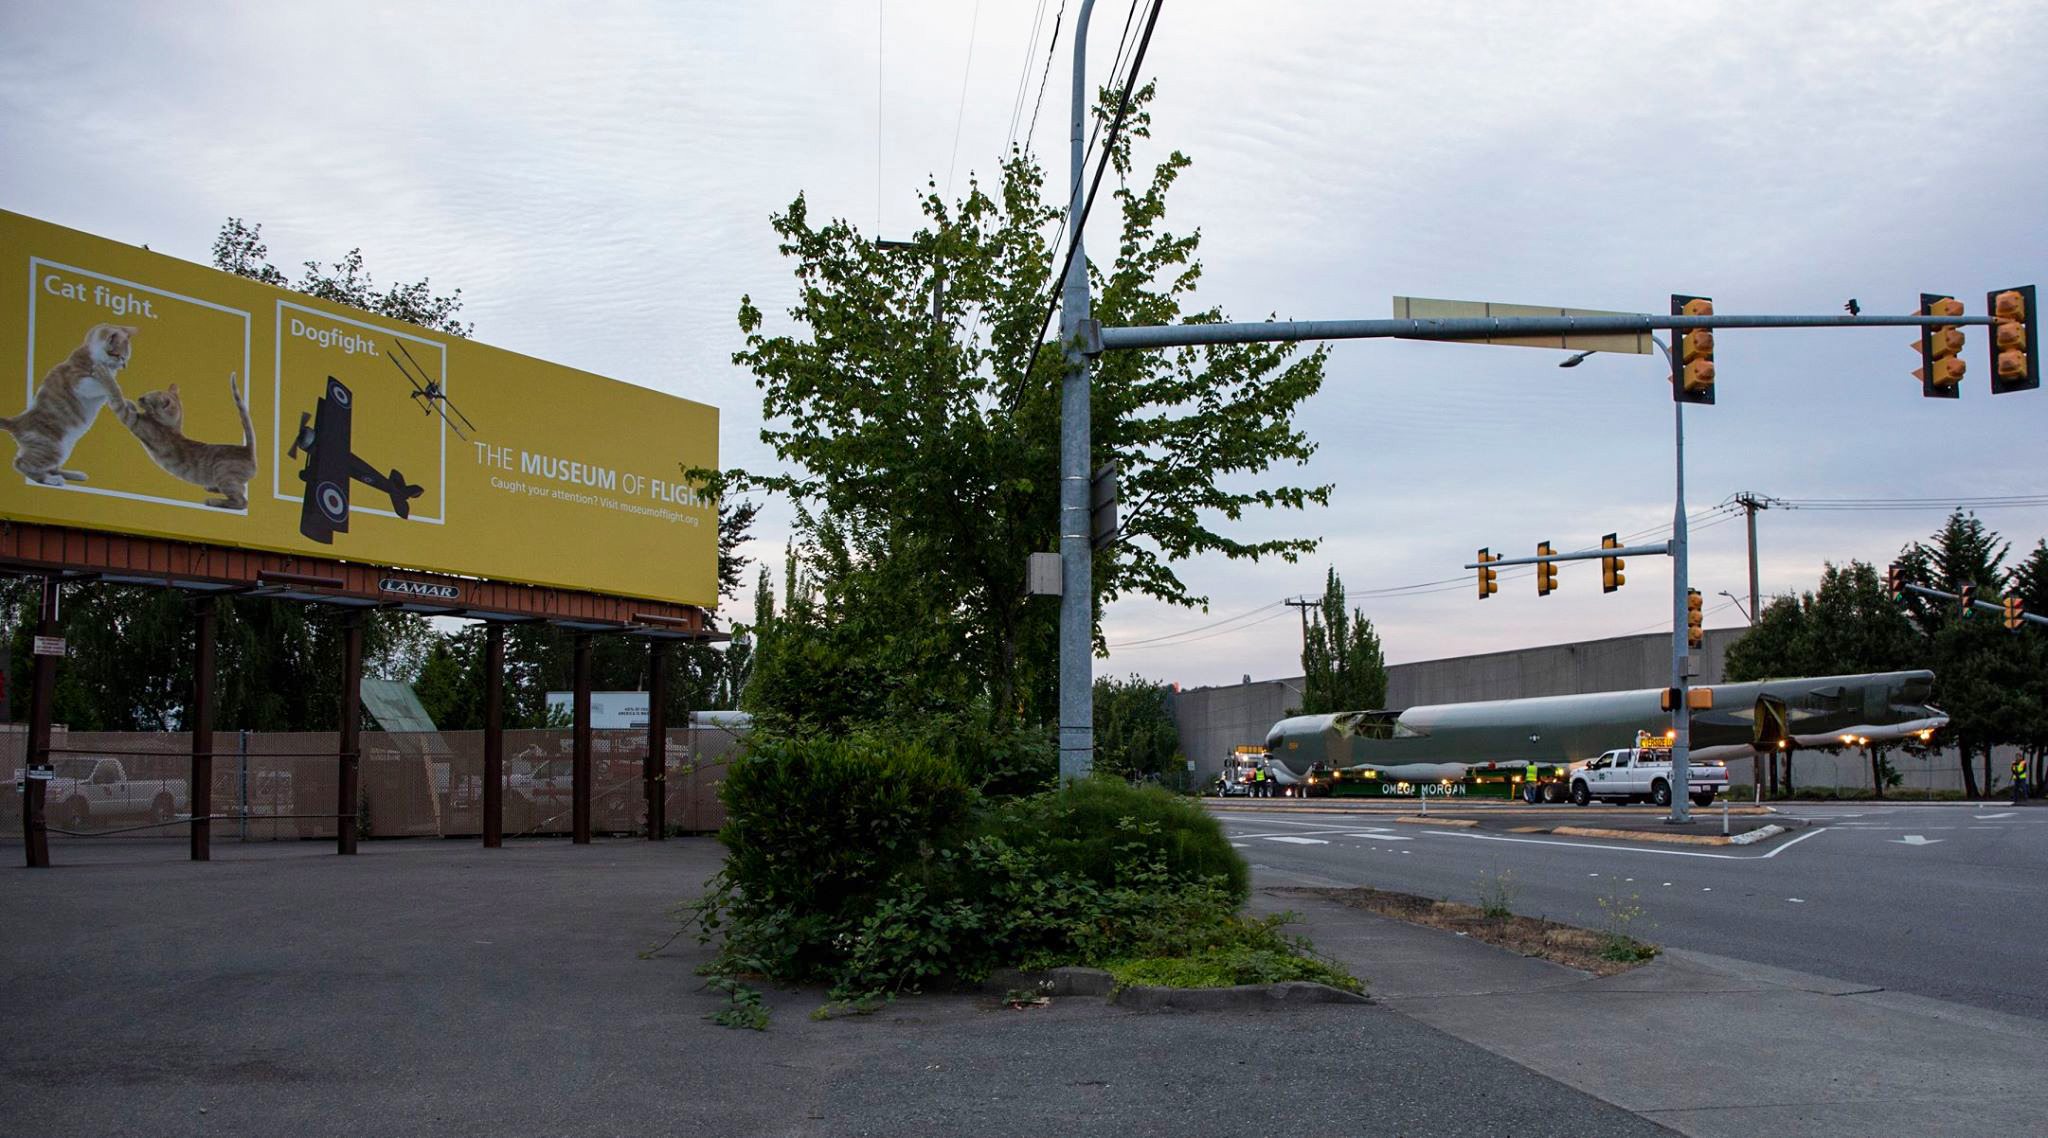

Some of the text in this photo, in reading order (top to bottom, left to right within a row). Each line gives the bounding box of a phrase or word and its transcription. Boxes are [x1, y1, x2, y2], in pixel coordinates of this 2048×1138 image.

[44, 275, 158, 319] Cat fight.
[291, 318, 379, 356] Dogfight.
[474, 441, 513, 470] THE
[521, 451, 616, 490] MUSEUM
[622, 472, 645, 496] OF
[490, 476, 699, 527] Caught your attention? Visit museumofflight.org
[386, 581, 452, 597] LAMAR
[1382, 783, 1466, 796] OMEGA MORGAN
